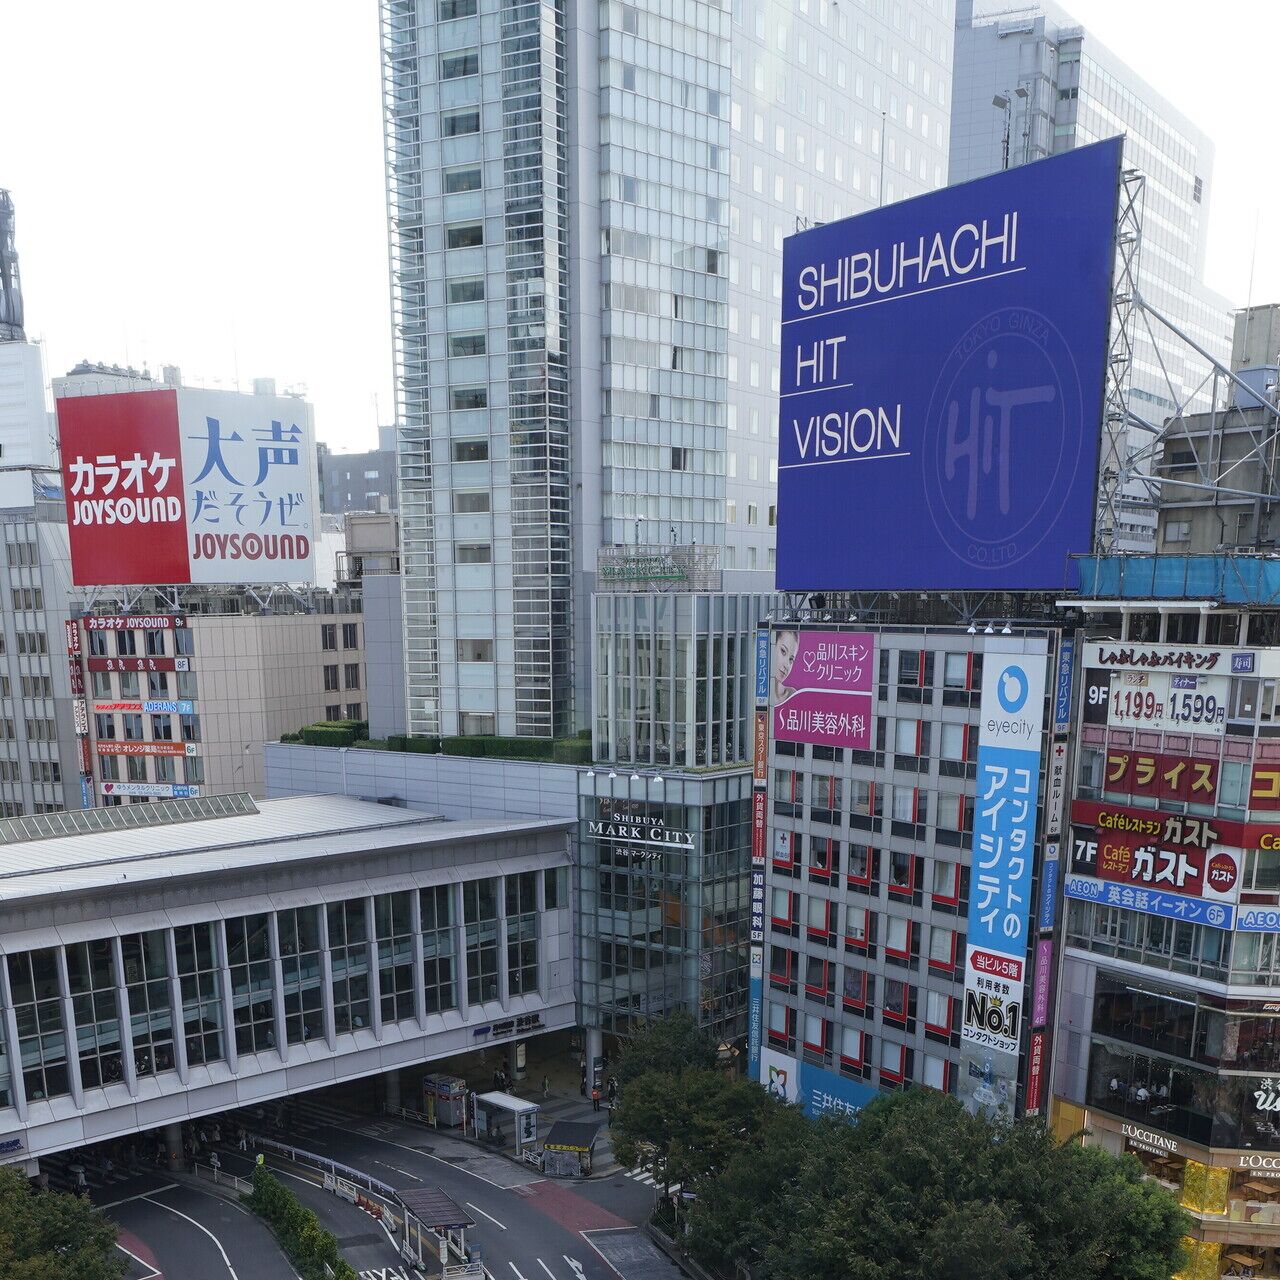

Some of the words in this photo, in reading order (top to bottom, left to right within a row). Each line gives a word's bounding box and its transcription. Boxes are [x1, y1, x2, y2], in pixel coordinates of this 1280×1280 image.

[797, 212, 1018, 311] SHIBUHACHI
[797, 336, 846, 386] HIT
[793, 405, 901, 458] VISION
[187, 416, 303, 487] 大声
[70, 452, 176, 496] カラオケ
[73, 496, 181, 526] JOYSOUND
[192, 490, 308, 529] だそうぜ。
[193, 533, 310, 560] JOYSOUND
[89, 618, 124, 629] カラオケ
[126, 617, 169, 628] JOYSOUND
[175, 618, 184, 627] 9F
[178, 660, 186, 668] 8F
[816, 643, 869, 662] 品川スキン
[1098, 648, 1220, 670] しゃぶしゃぶバイキング
[816, 664, 862, 682] クリニック
[1058, 652, 1070, 719] 東急リバブル
[144, 702, 178, 712] ADERANS
[1088, 686, 1108, 704] 9F
[1114, 690, 1164, 722] 1,199円
[1170, 692, 1224, 725] 1,599円
[787, 710, 866, 738] 品川美容外科
[988, 719, 1034, 739] eyecity
[1108, 755, 1214, 790] プライス
[588, 821, 641, 838] MARK
[650, 828, 696, 844] CITY
[614, 813, 664, 826] SHIBUYA
[1164, 817, 1218, 848] ガスト
[631, 849, 662, 860] マークシティ
[977, 765, 1009, 933] アイシティ
[1003, 768, 1031, 939] コンタクトの
[1076, 840, 1098, 862] 7F
[1104, 844, 1130, 862] Café
[1102, 862, 1130, 874] レストラン
[1132, 846, 1198, 887] ガスト
[1211, 870, 1234, 882] ガスト
[752, 874, 763, 928] 加藤眼科
[1070, 878, 1100, 898] AEON
[1108, 885, 1202, 918] 英会話イーオン
[976, 956, 1019, 978] 当ビル5階
[976, 977, 1010, 996] 利用者数
[964, 989, 1020, 1041] No.1
[963, 1028, 1017, 1052] コンタクトショップ
[1122, 1123, 1178, 1152] L'OCCITANE
